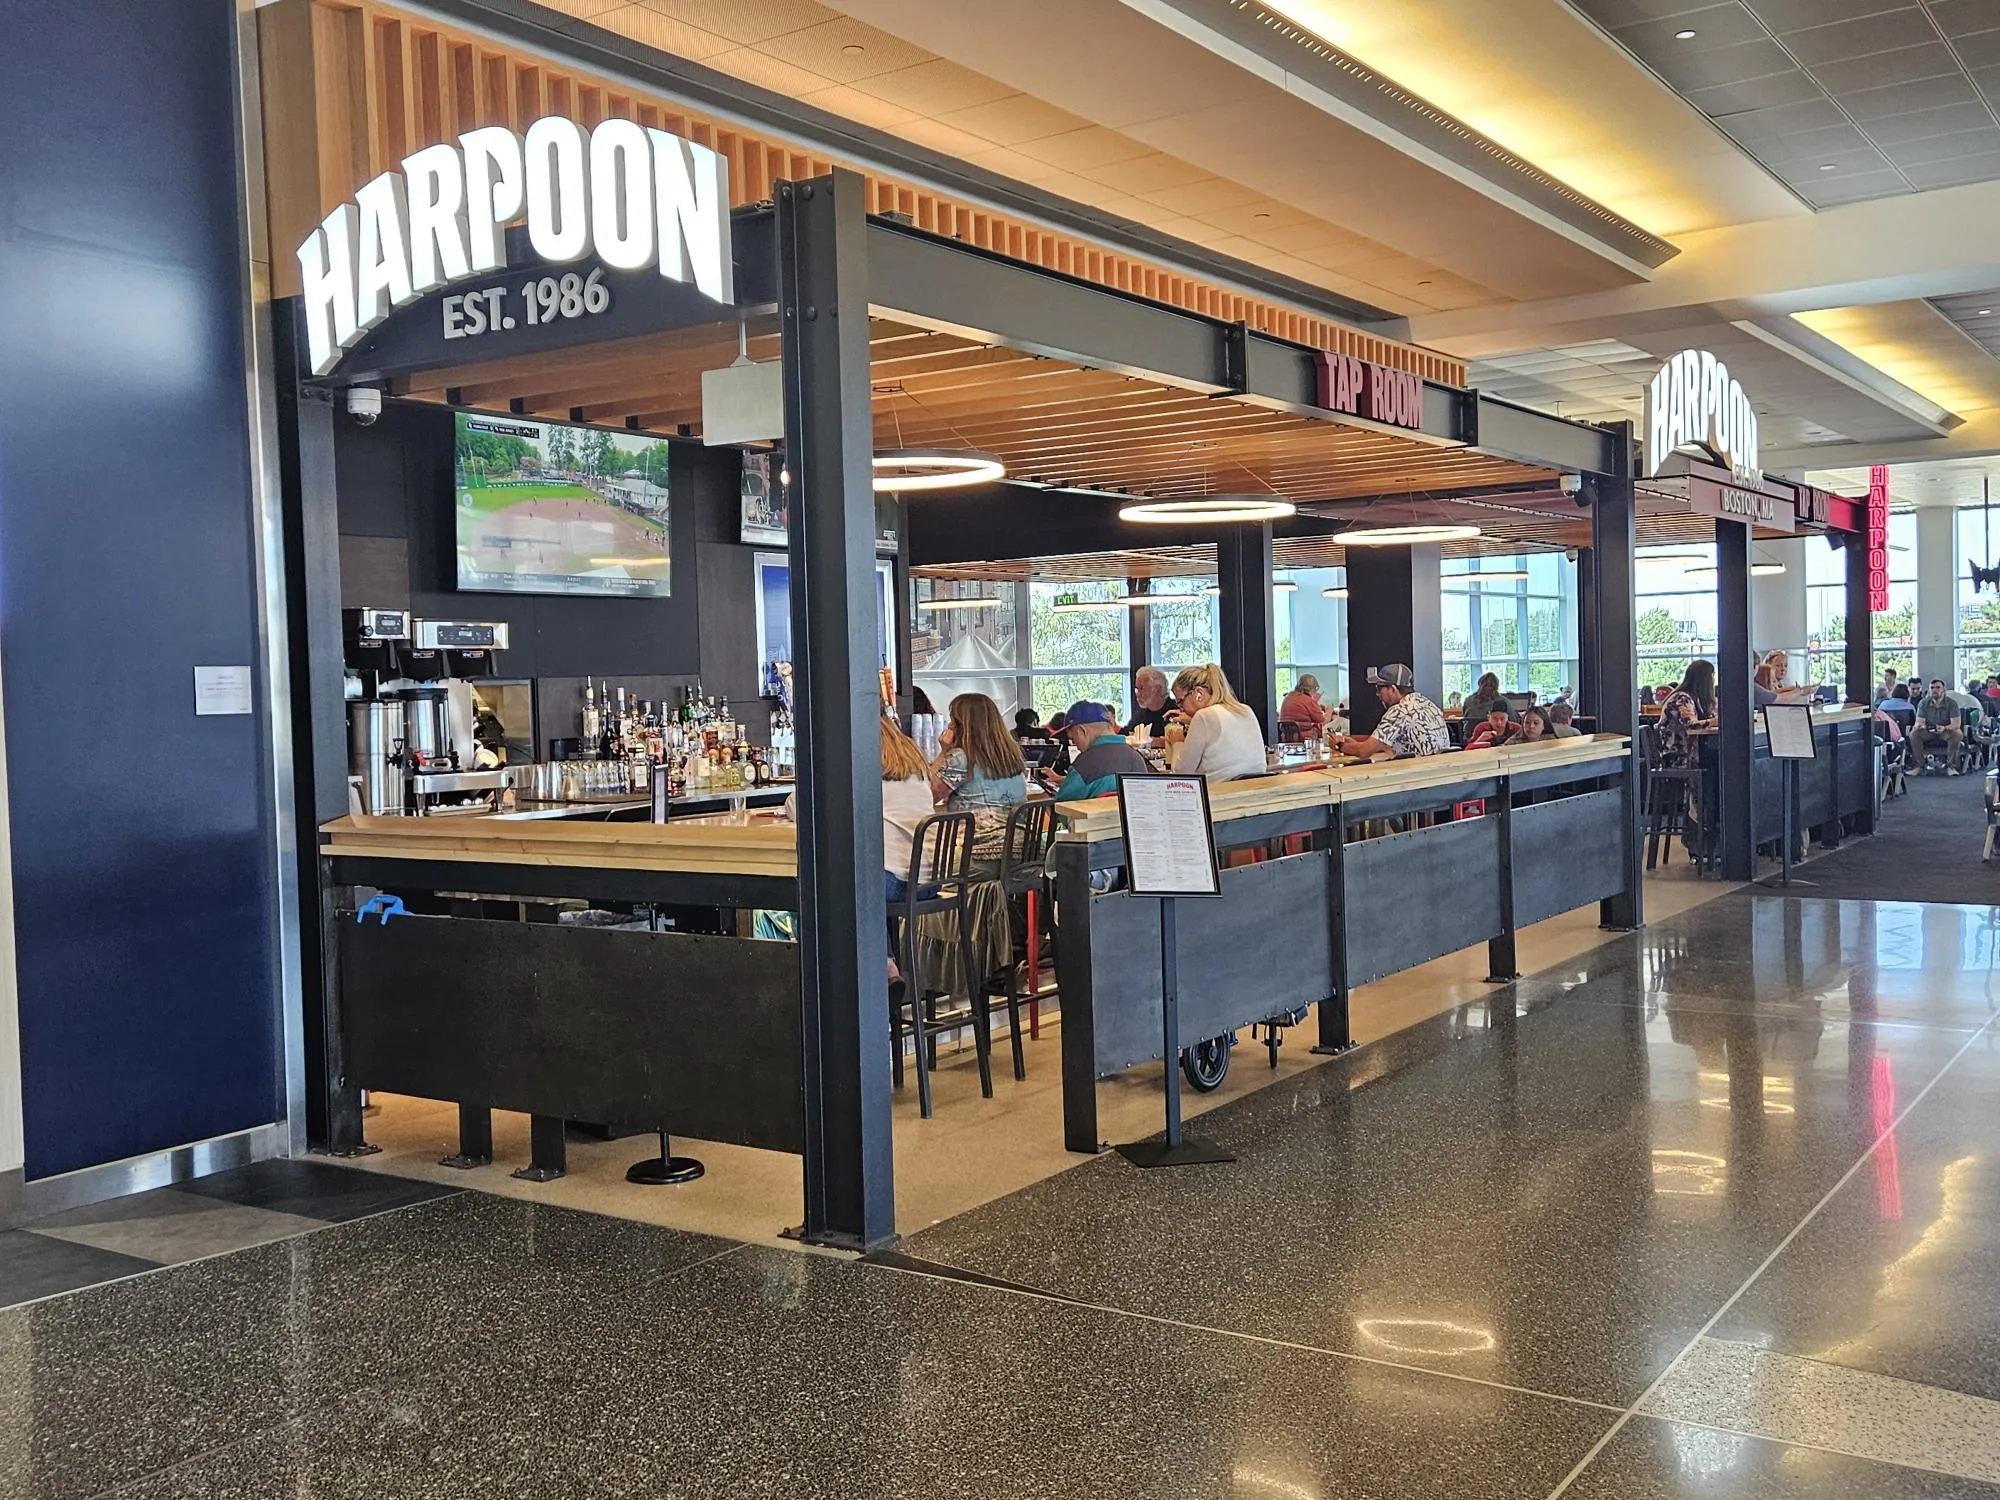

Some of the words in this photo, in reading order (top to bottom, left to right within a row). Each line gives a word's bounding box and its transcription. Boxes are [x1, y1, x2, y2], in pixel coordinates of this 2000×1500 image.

[296, 115, 733, 377] HARPOON
[442, 286, 516, 340] EST.
[521, 266, 609, 325] 1986
[1320, 351, 1364, 414] TAP
[1370, 364, 1424, 429] ROOM
[1650, 348, 1758, 478] HARPOON
[1723, 489, 1760, 520] BOSTON,
[1763, 498, 1774, 520] MA
[1869, 464, 1886, 611] HARPOON
